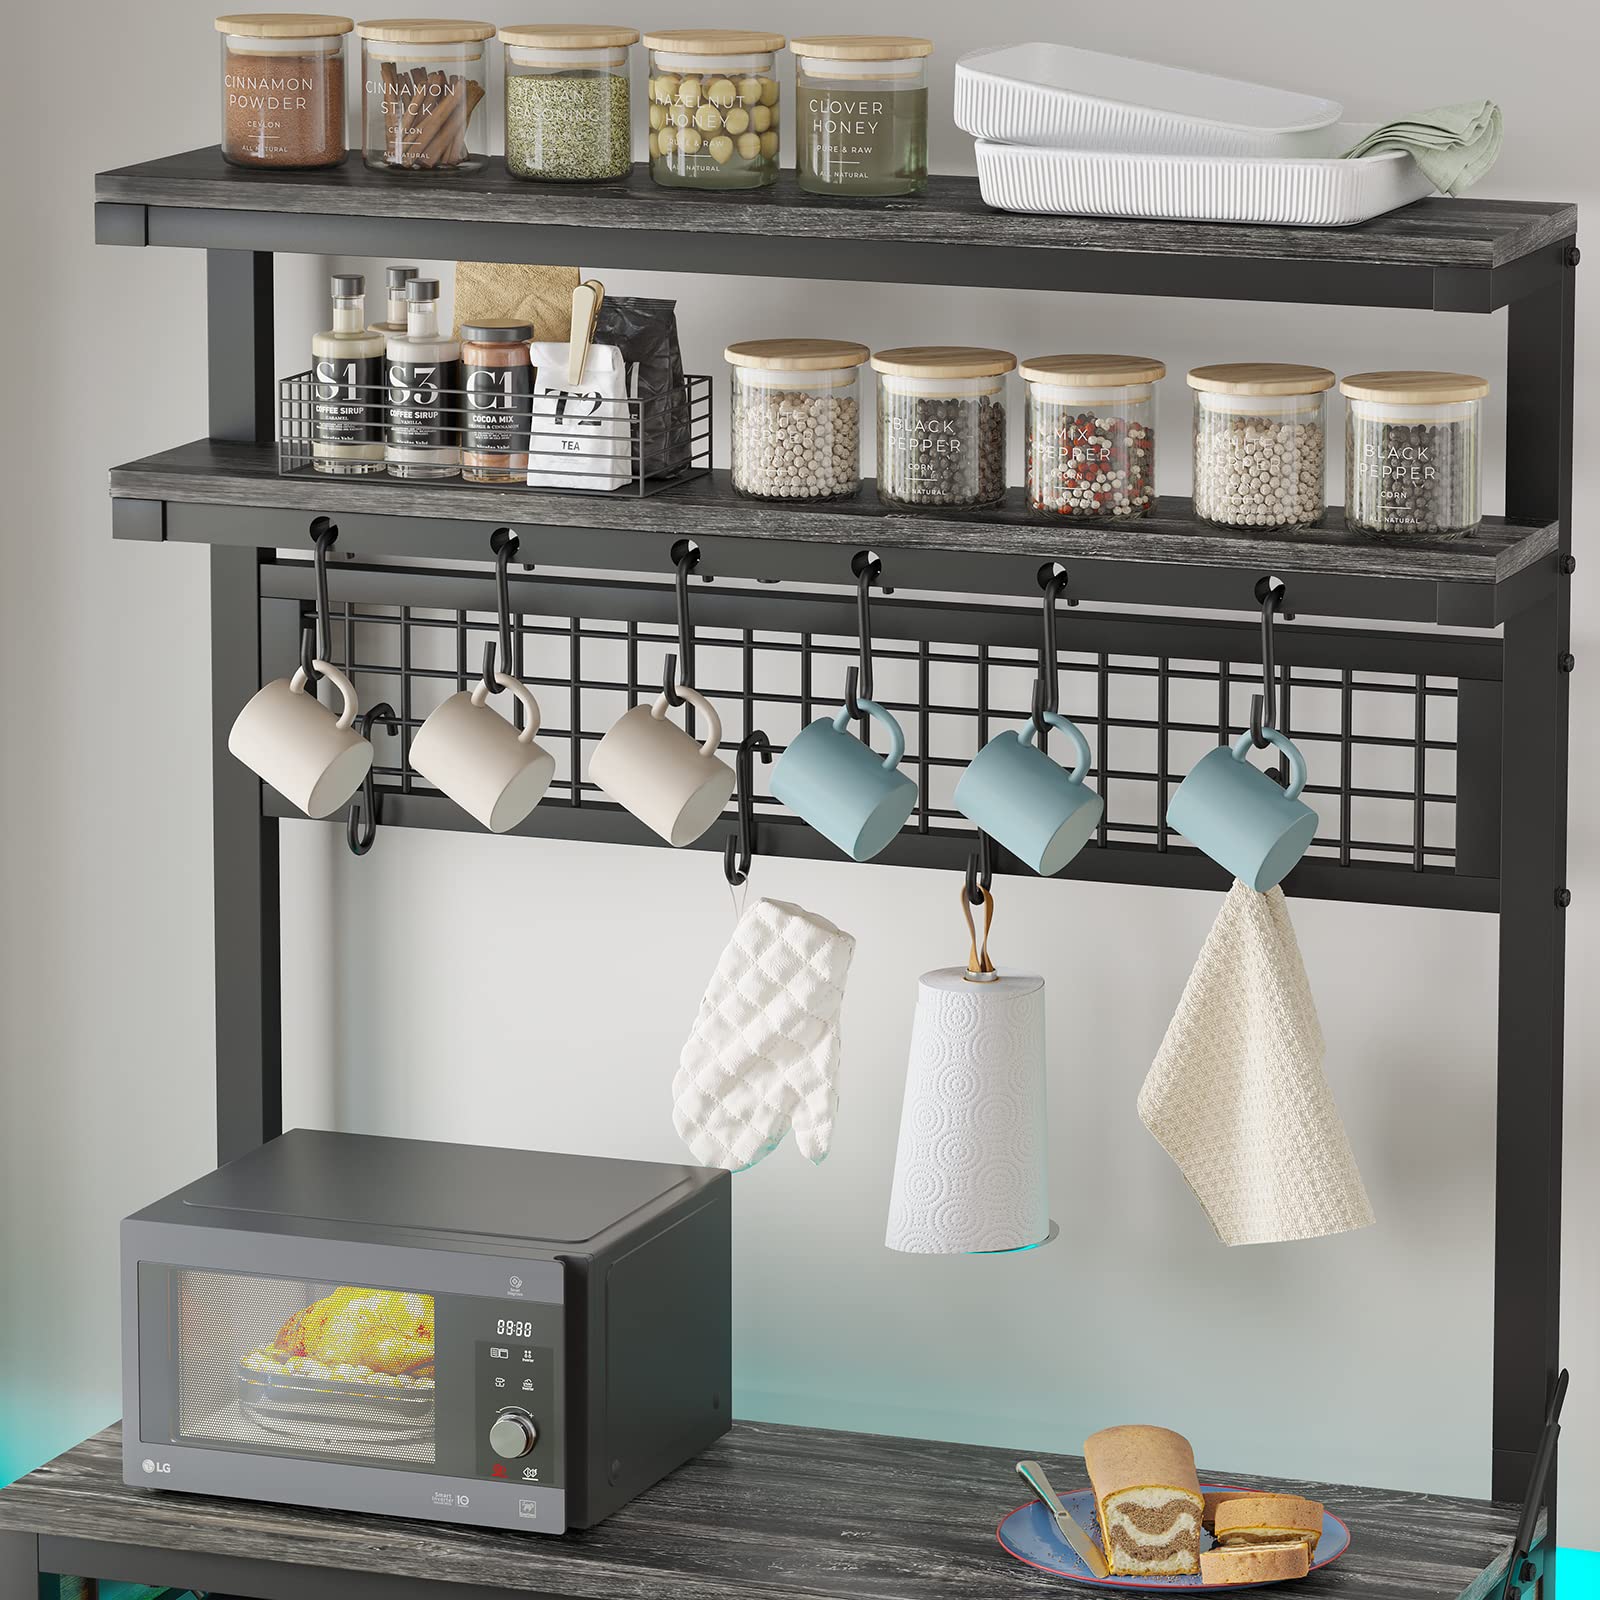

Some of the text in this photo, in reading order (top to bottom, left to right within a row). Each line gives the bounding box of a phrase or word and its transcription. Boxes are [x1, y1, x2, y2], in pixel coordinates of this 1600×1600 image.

[224, 74, 313, 90] CINNAMON
[365, 80, 455, 97] CINNAMON
[229, 94, 306, 110] POWDER
[381, 101, 433, 116] STICK
[655, 94, 745, 109] HAZELNUT
[809, 99, 883, 114] CLOVER
[247, 120, 281, 128] CEYLON
[665, 112, 730, 128] HONEY
[813, 119, 879, 135] HONEY
[388, 126, 423, 134] CEYLON
[817, 145, 841, 153] PURE
[315, 361, 362, 401] S1
[388, 365, 439, 405] S3
[466, 371, 518, 410] C1
[316, 405, 364, 415] COFFEE SIRUP
[390, 409, 438, 419] COFFEE SIRUP
[545, 388, 602, 426] T2
[472, 415, 497, 423] COCOA
[893, 417, 954, 433] BLACK
[1054, 428, 1088, 441] MIX
[561, 440, 580, 451] TEA
[888, 436, 961, 452] PEPPER
[1037, 446, 1111, 461] PEPPER
[1364, 444, 1429, 460] BLACK
[907, 463, 933, 471] CORN
[1360, 462, 1436, 480] PEPPER
[1380, 491, 1407, 499] CORN
[156, 1462, 171, 1473] LG
